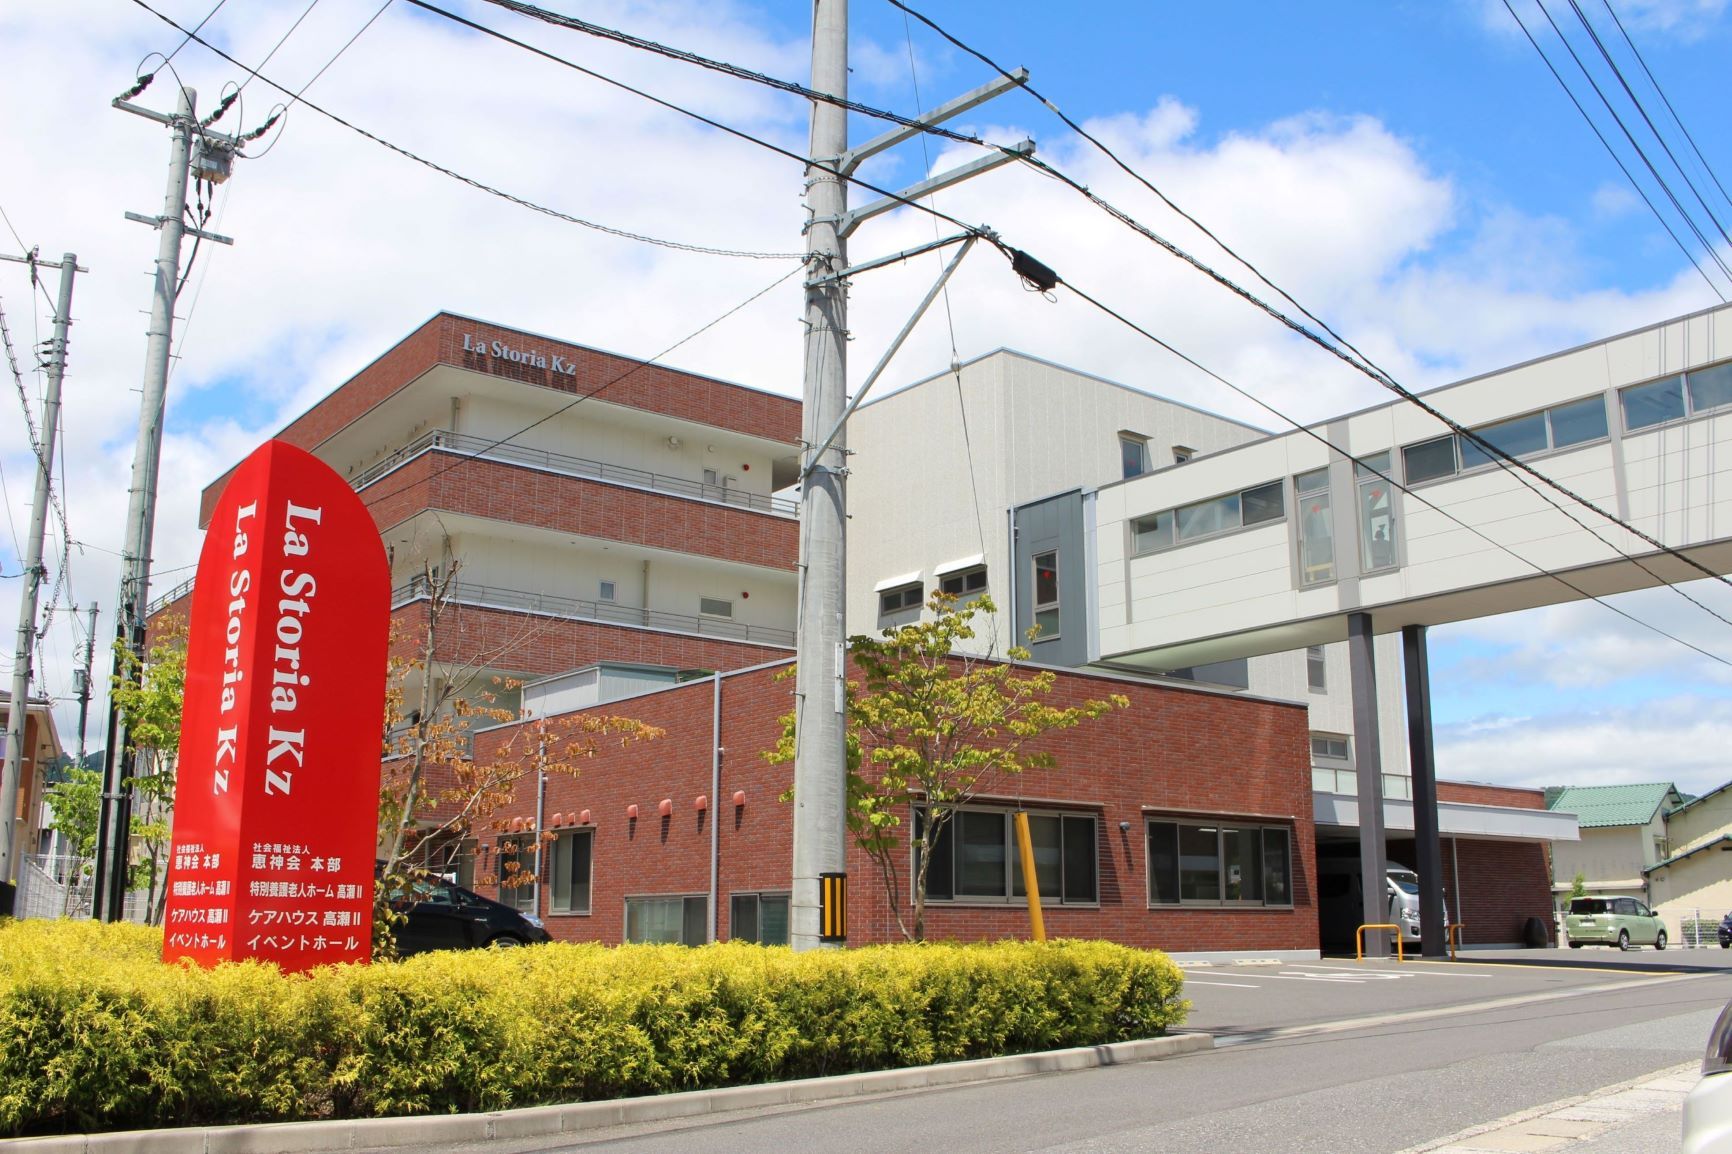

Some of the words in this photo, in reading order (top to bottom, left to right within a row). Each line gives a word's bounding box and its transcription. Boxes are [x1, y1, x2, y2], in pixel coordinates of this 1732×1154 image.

[463, 333, 486, 354] La
[491, 340, 546, 368] Storia
[551, 355, 576, 375] Kz
[232, 499, 257, 561] La
[282, 498, 322, 558] La
[219, 568, 252, 715] Storia
[269, 568, 318, 714] Storia
[212, 724, 239, 797] Kz
[264, 724, 306, 797] Kz
[253, 843, 310, 855] 社会福祉法人
[202, 853, 220, 870] 本部
[310, 856, 341, 873] 本部
[249, 880, 334, 898] 特別養護老人ホーム
[171, 909, 205, 923] ケアハウス
[248, 909, 319, 926] ケアハウス
[169, 932, 226, 950] イベントホール
[247, 934, 360, 951] イベントホール
